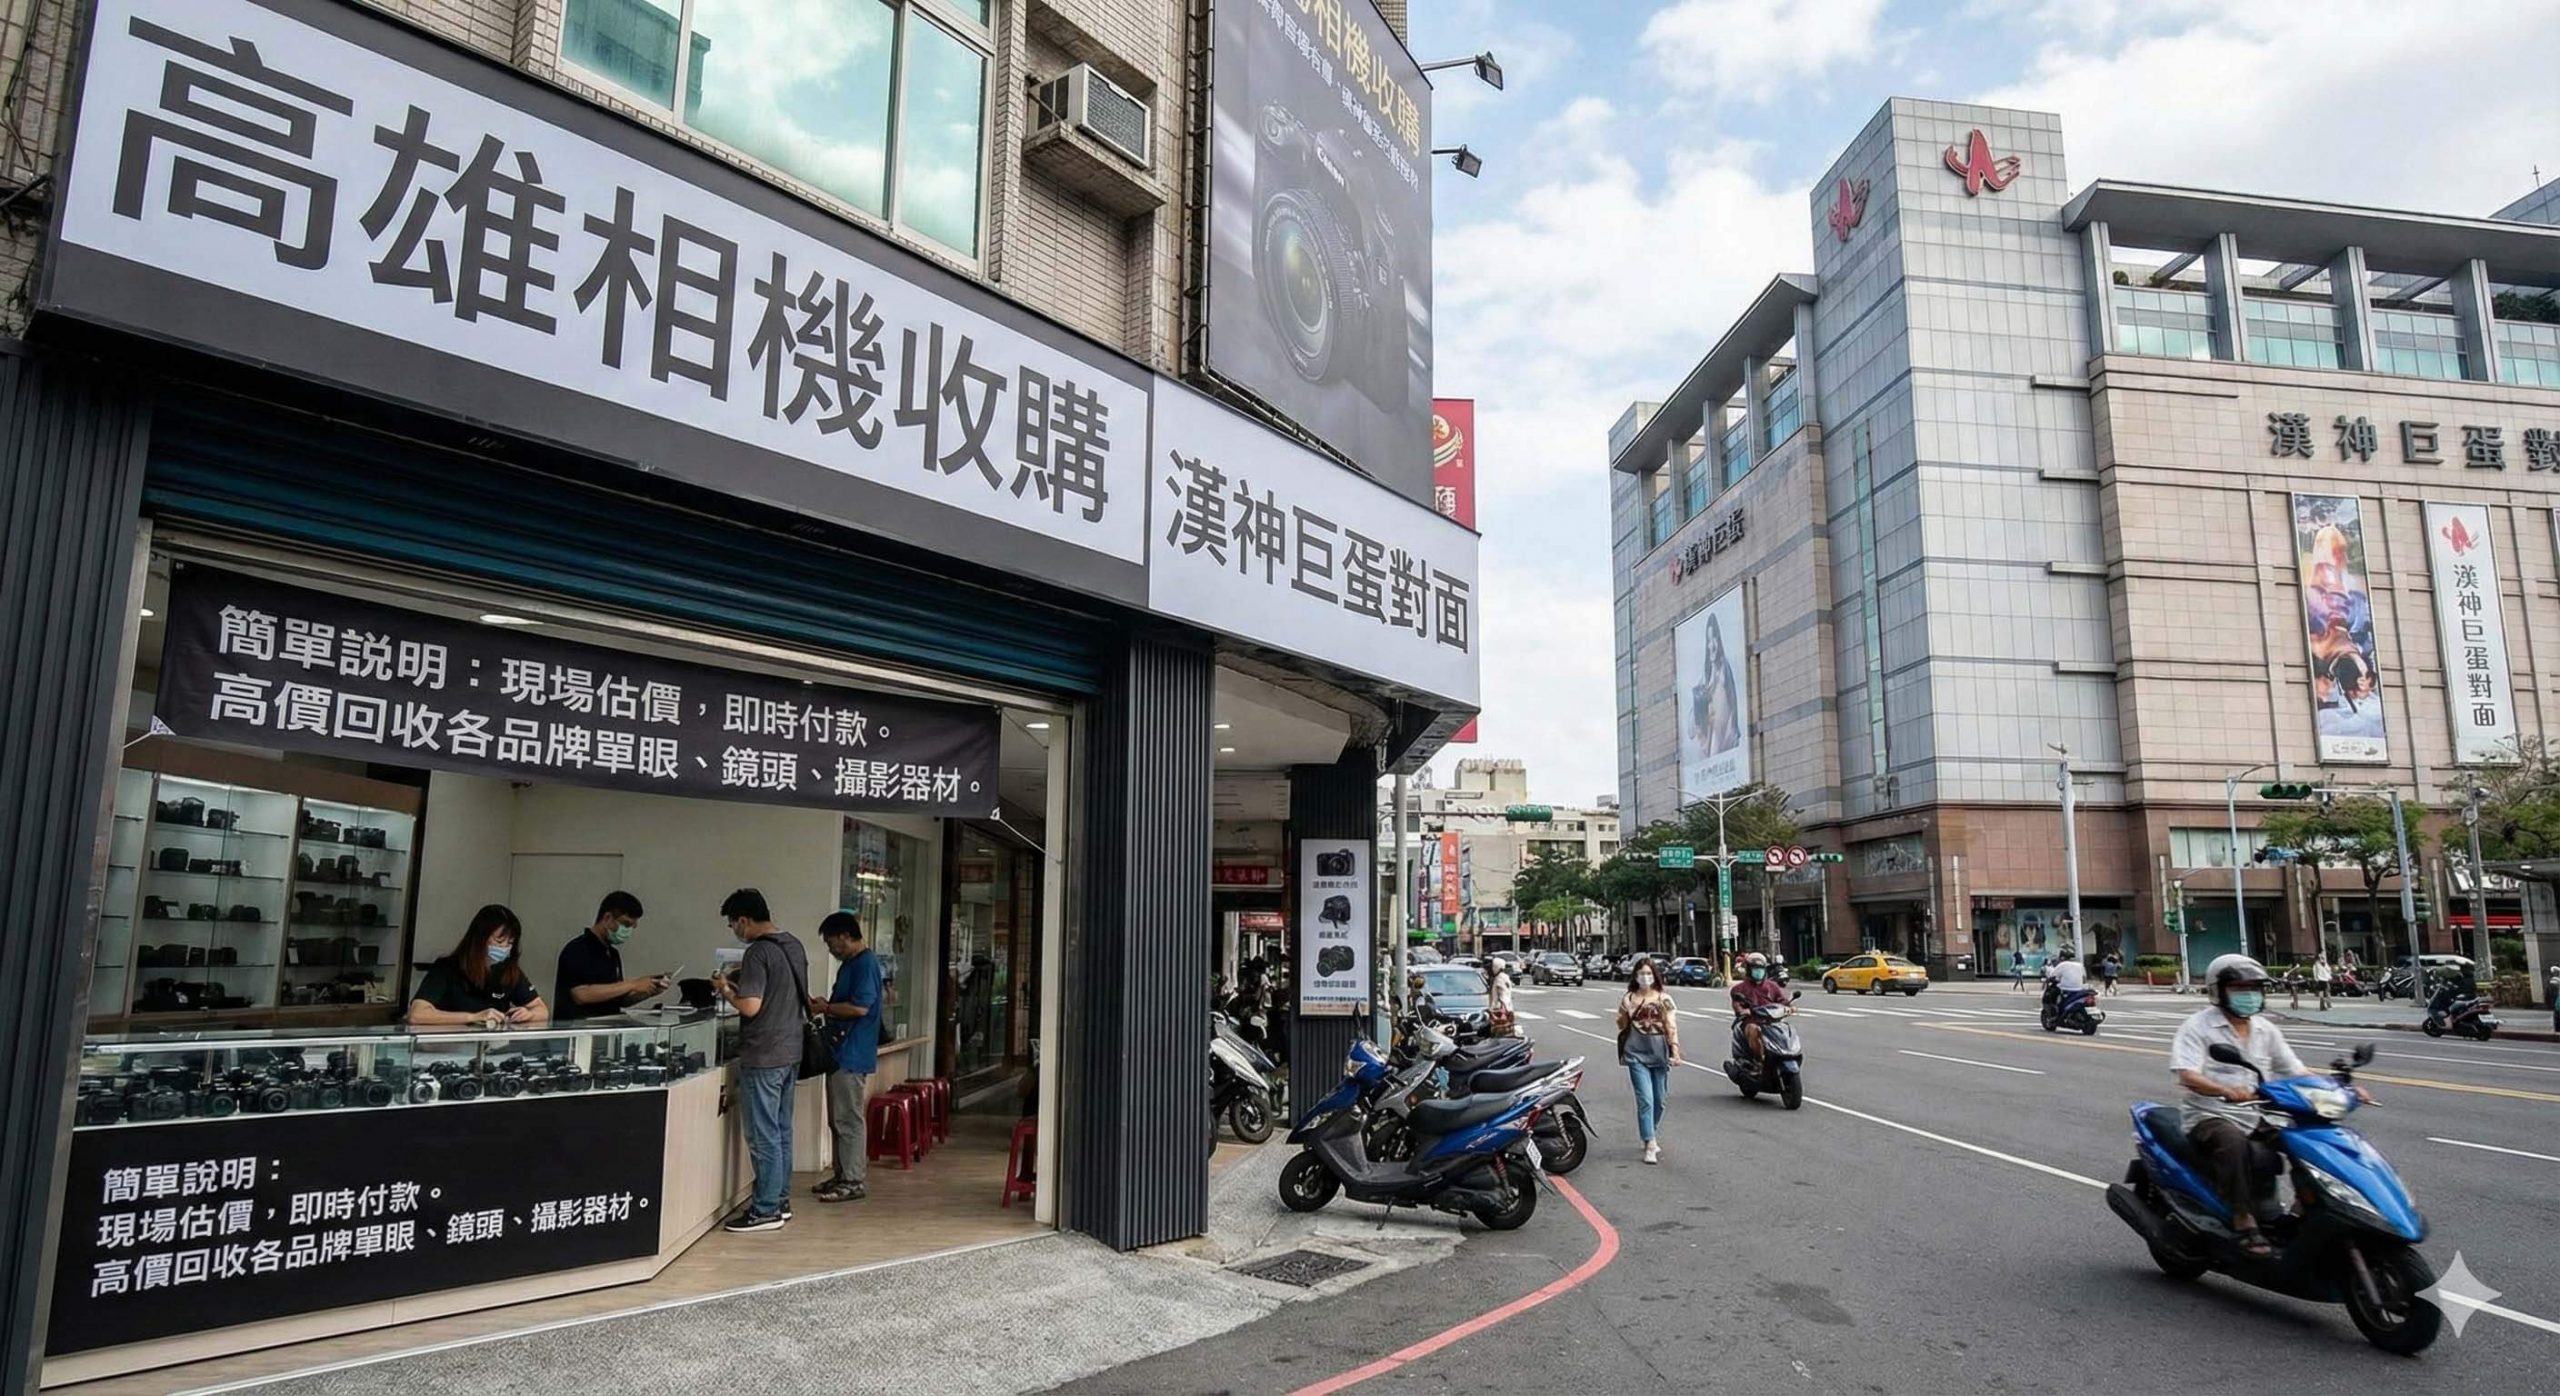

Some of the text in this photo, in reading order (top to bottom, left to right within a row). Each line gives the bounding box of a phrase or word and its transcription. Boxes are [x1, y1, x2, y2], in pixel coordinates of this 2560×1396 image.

[1294, 0, 1420, 158] 相機收購
[113, 16, 1111, 523] 高雄相機收購
[1166, 449, 1470, 655] 漢神巨蛋對面
[2453, 564, 2496, 727] 漢神巨蛋對面
[210, 672, 981, 804] 高價回收各品牌單眼、鏡頭、攝影器材。
[91, 1192, 650, 1298] 高價回收各品牌單眼、鏡頭、攝影器材。
[96, 1181, 443, 1249] 現場估價，即時付款。
